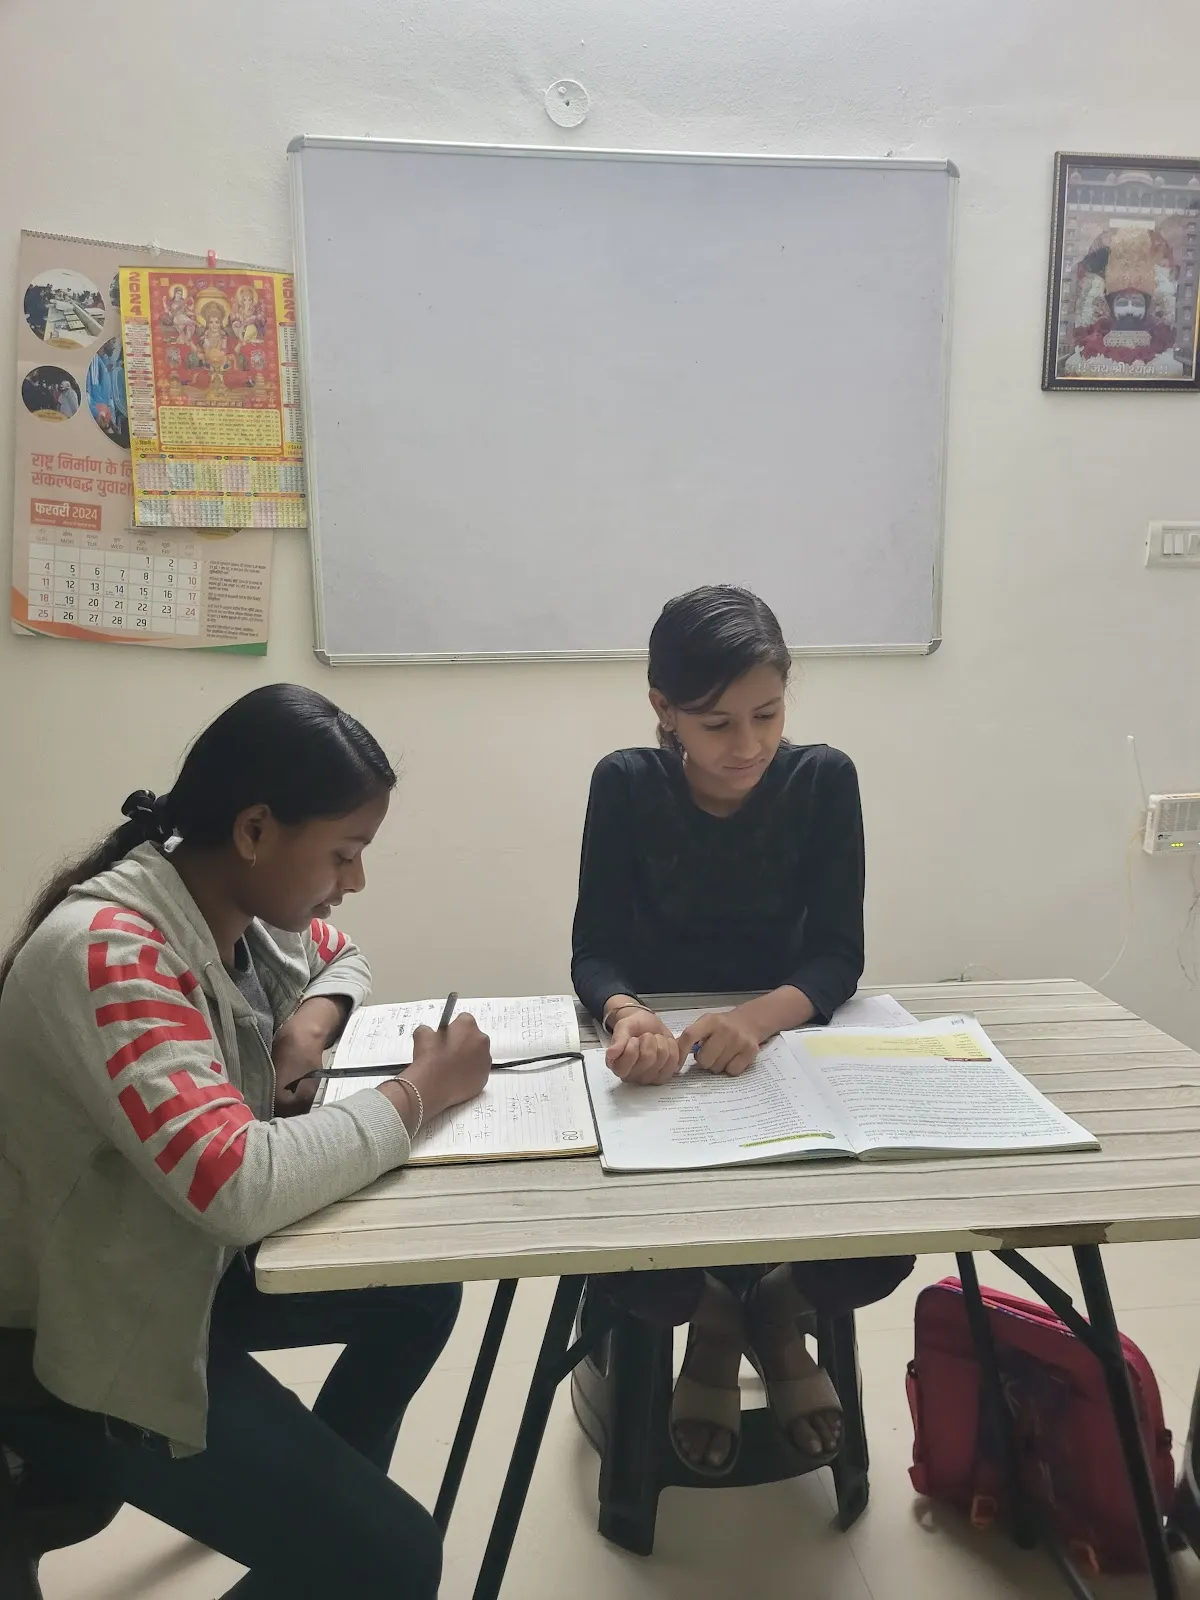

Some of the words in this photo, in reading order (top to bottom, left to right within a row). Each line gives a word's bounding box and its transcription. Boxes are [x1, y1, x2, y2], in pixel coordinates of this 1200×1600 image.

[128, 272, 142, 316] 2024
[282, 277, 295, 322] 2024
[1090, 363, 1109, 373] जय
[1112, 361, 1126, 374] श्री
[1128, 364, 1155, 375] श्याम
[30, 453, 54, 471] राष्ट्र
[57, 452, 102, 474] निर्माण
[104, 458, 119, 476] के
[30, 469, 94, 492] संकल्पबद्ध
[34, 502, 70, 518] फरवरी
[72, 506, 98, 520] 2024
[42, 578, 50, 586] 11
[66, 580, 75, 588] 12
[91, 583, 100, 591] 13
[115, 585, 124, 594] 14
[140, 588, 148, 596] 15
[163, 590, 172, 599] 16
[188, 592, 196, 601] 17
[188, 577, 197, 585] 10
[40, 593, 49, 602] 18
[65, 596, 74, 605] 19
[88, 598, 99, 607] 20
[114, 601, 123, 609] 21
[137, 603, 148, 612] 22
[161, 606, 172, 614] 23
[185, 608, 196, 616] 24
[38, 609, 49, 618] 25
[63, 612, 74, 620] 26
[88, 614, 99, 623] 27
[111, 616, 123, 625] 28
[136, 618, 147, 627] 29
